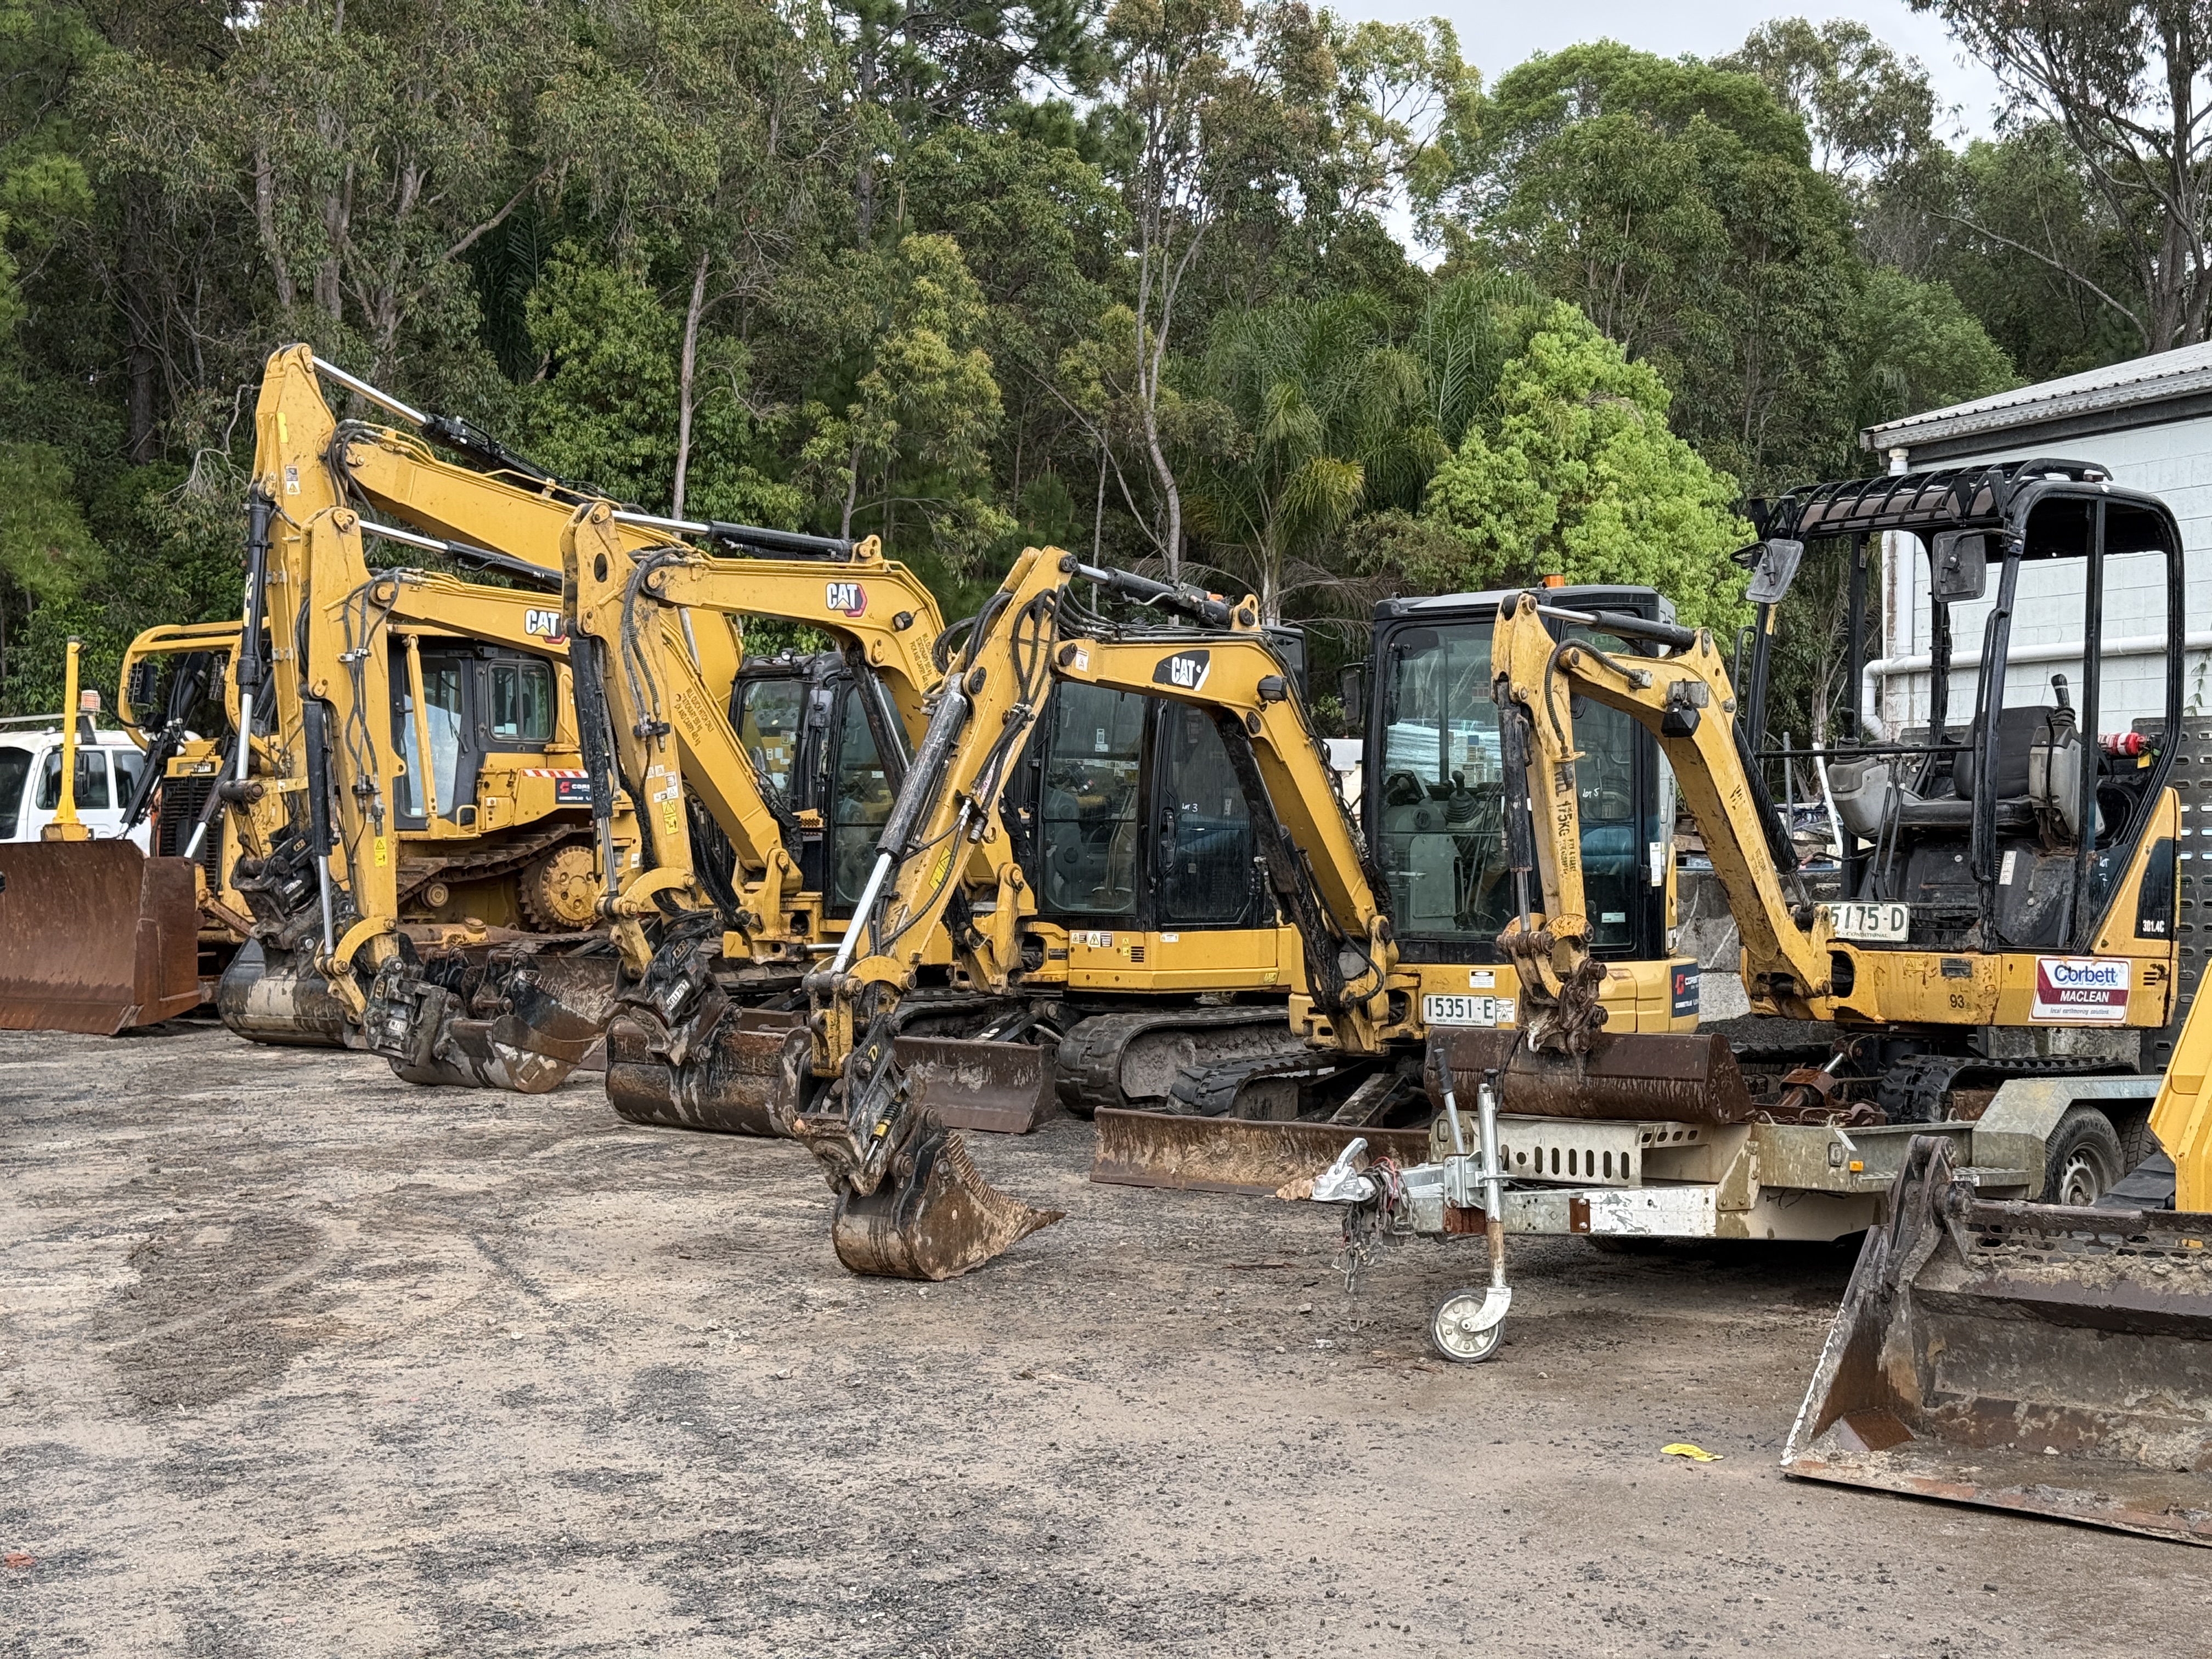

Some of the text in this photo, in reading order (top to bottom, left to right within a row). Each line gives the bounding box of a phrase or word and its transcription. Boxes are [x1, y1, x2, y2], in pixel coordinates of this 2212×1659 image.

[827, 583, 857, 610] CAT
[526, 610, 559, 637] CAT
[1172, 657, 1195, 686] CAT
[1593, 787, 1600, 797] 5
[1192, 803, 1198, 812] 3
[1830, 906, 1904, 932] 5175-D
[2142, 919, 2165, 933] 301.4C
[2054, 964, 2118, 986] Corbett
[1950, 994, 1965, 1008] 93
[2059, 990, 2110, 1003] MACLEAN
